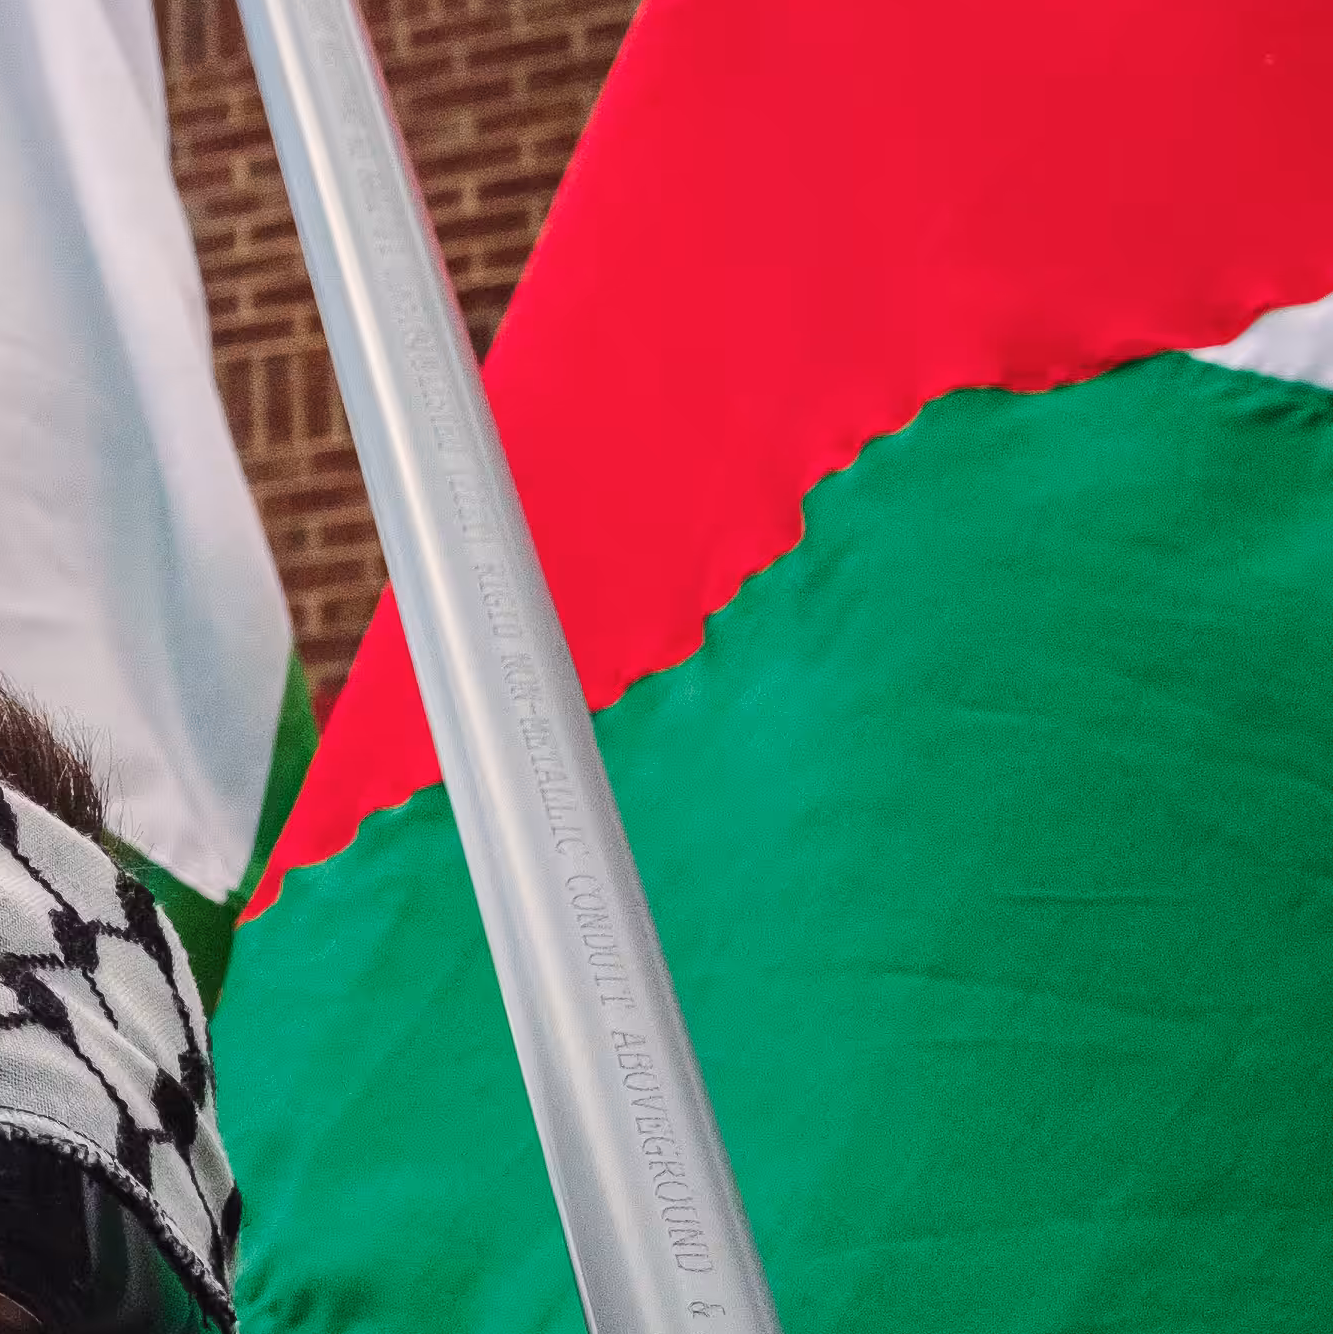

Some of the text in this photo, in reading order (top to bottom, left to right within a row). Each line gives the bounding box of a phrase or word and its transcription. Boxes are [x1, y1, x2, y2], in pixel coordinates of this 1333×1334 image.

[564, 873, 636, 1007] CONDUIT
[609, 1030, 716, 1271] ABOVEGROUND
[687, 1301, 726, 1320] &
